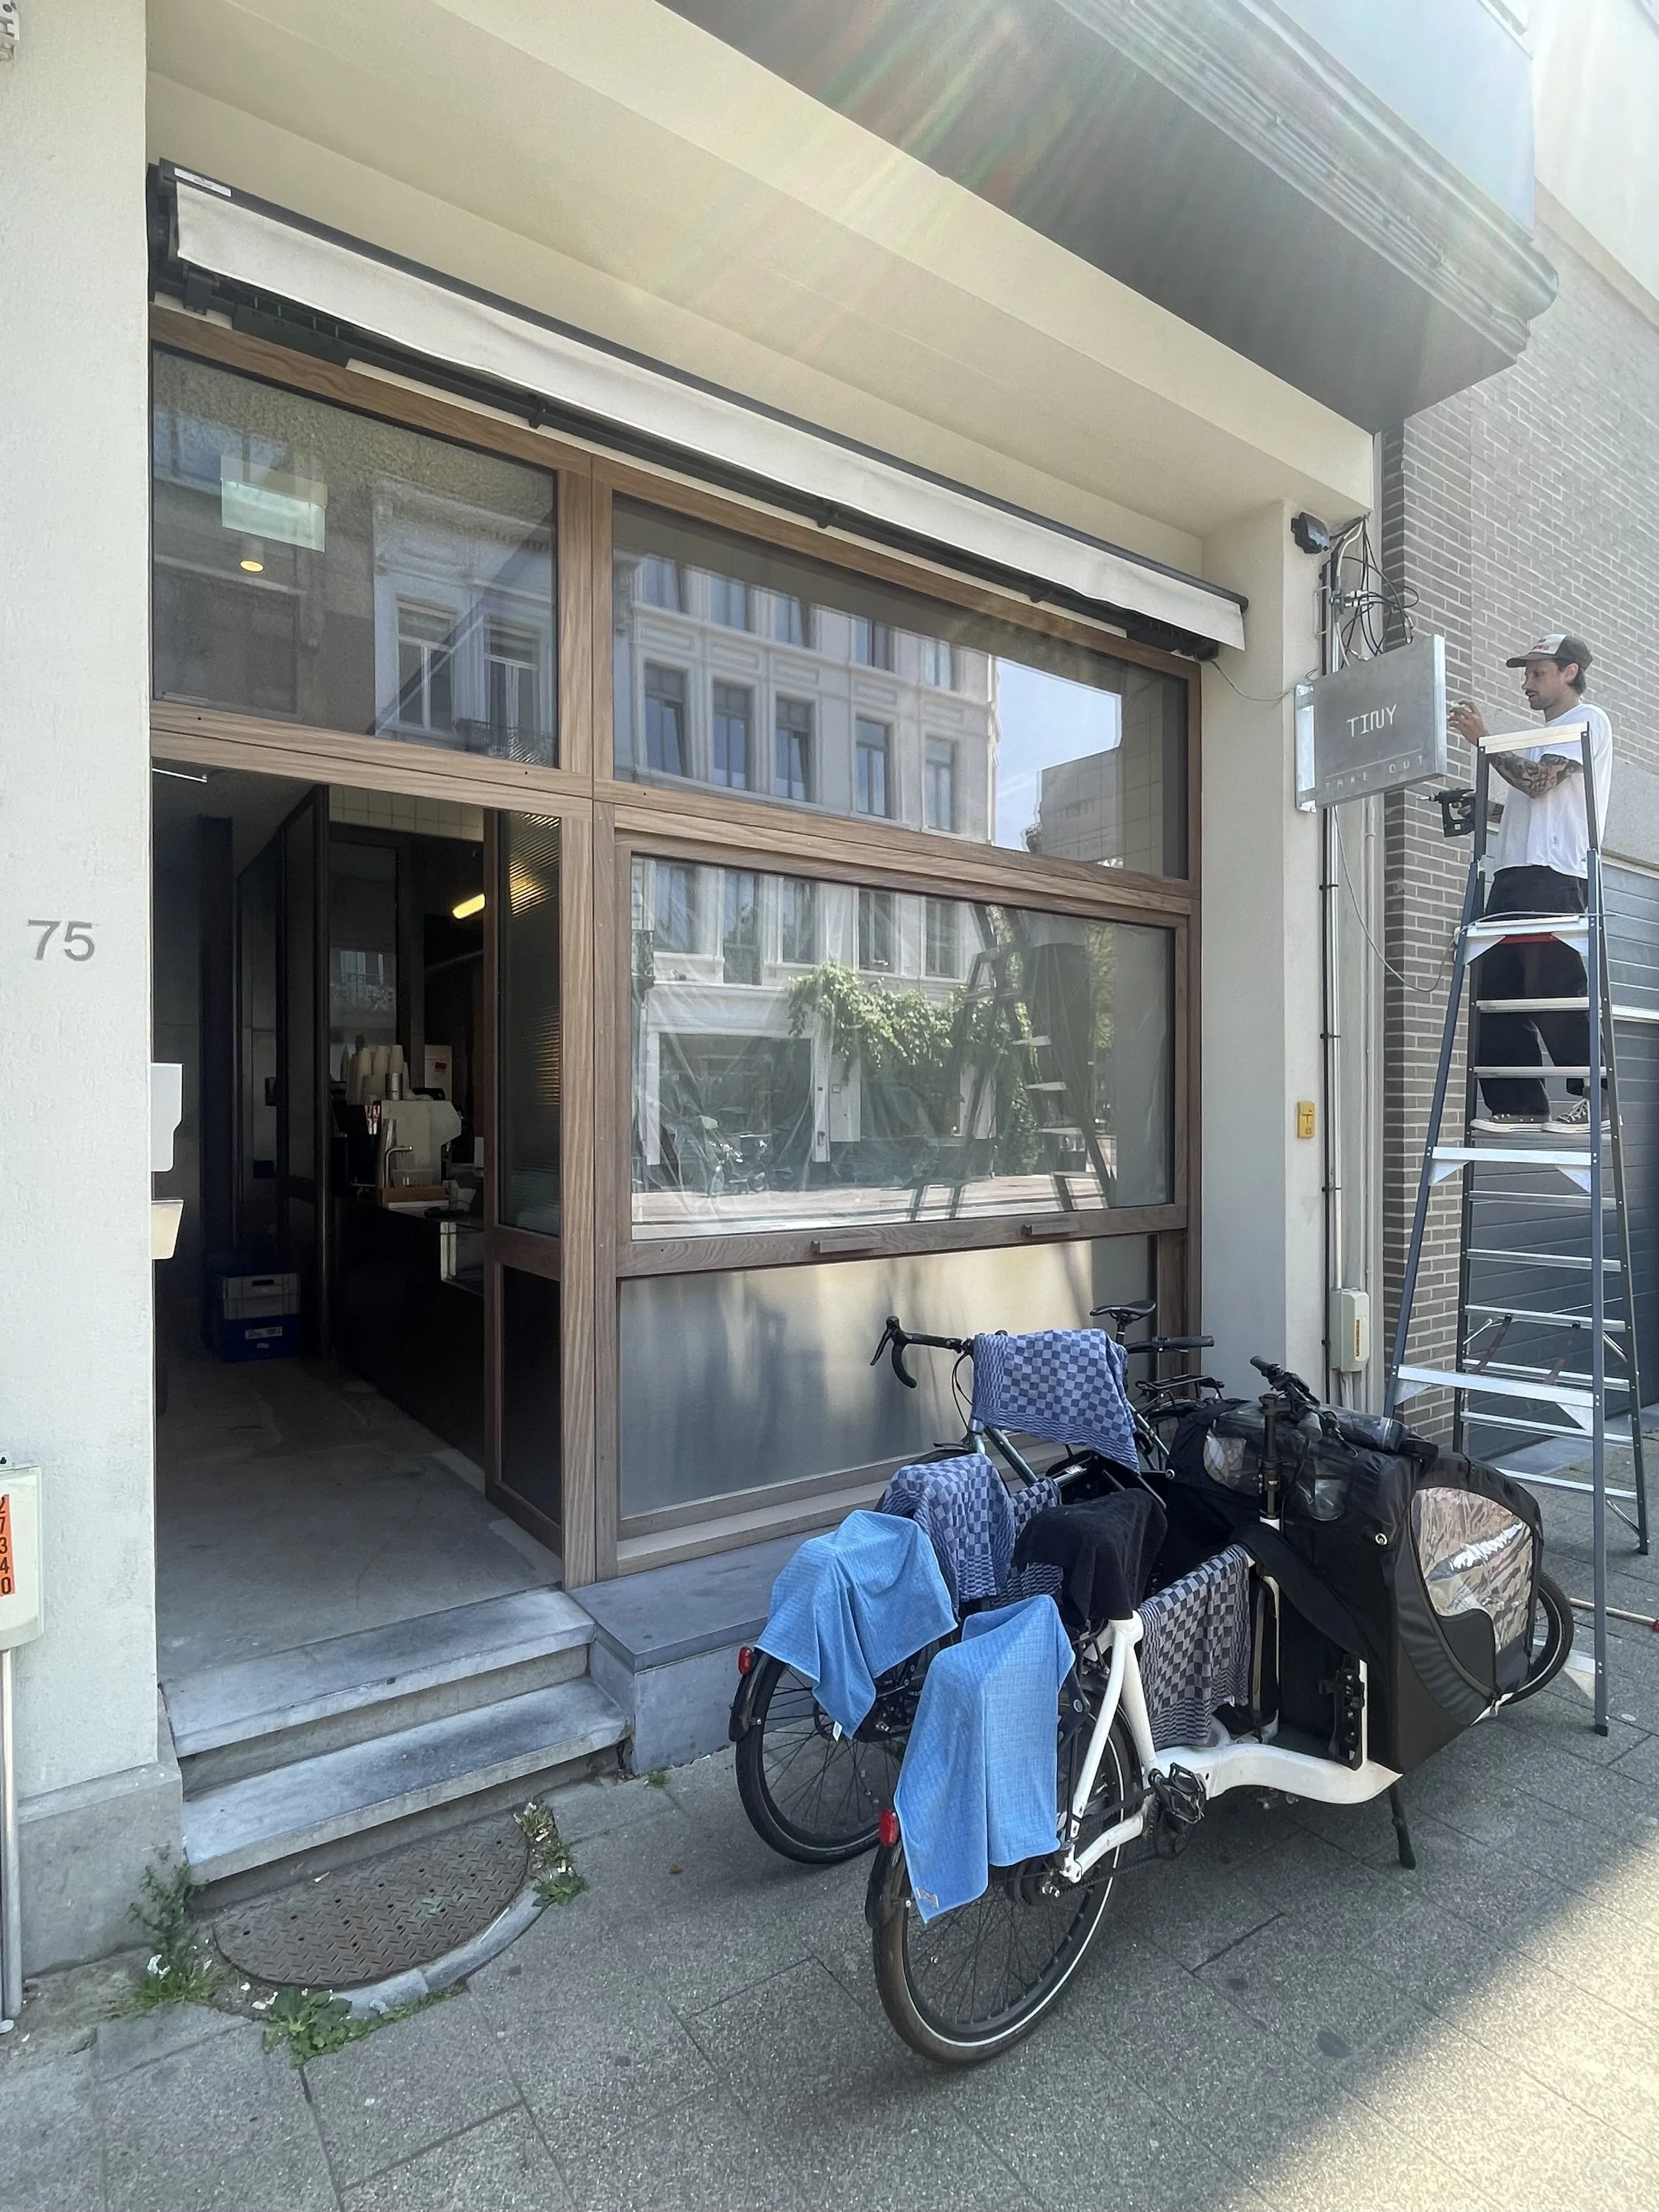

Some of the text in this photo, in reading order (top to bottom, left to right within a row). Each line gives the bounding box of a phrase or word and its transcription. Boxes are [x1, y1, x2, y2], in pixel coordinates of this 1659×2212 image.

[1346, 704, 1398, 737] TINY
[1326, 755, 1424, 792] TAKE OUT
[28, 919, 96, 961] 75
